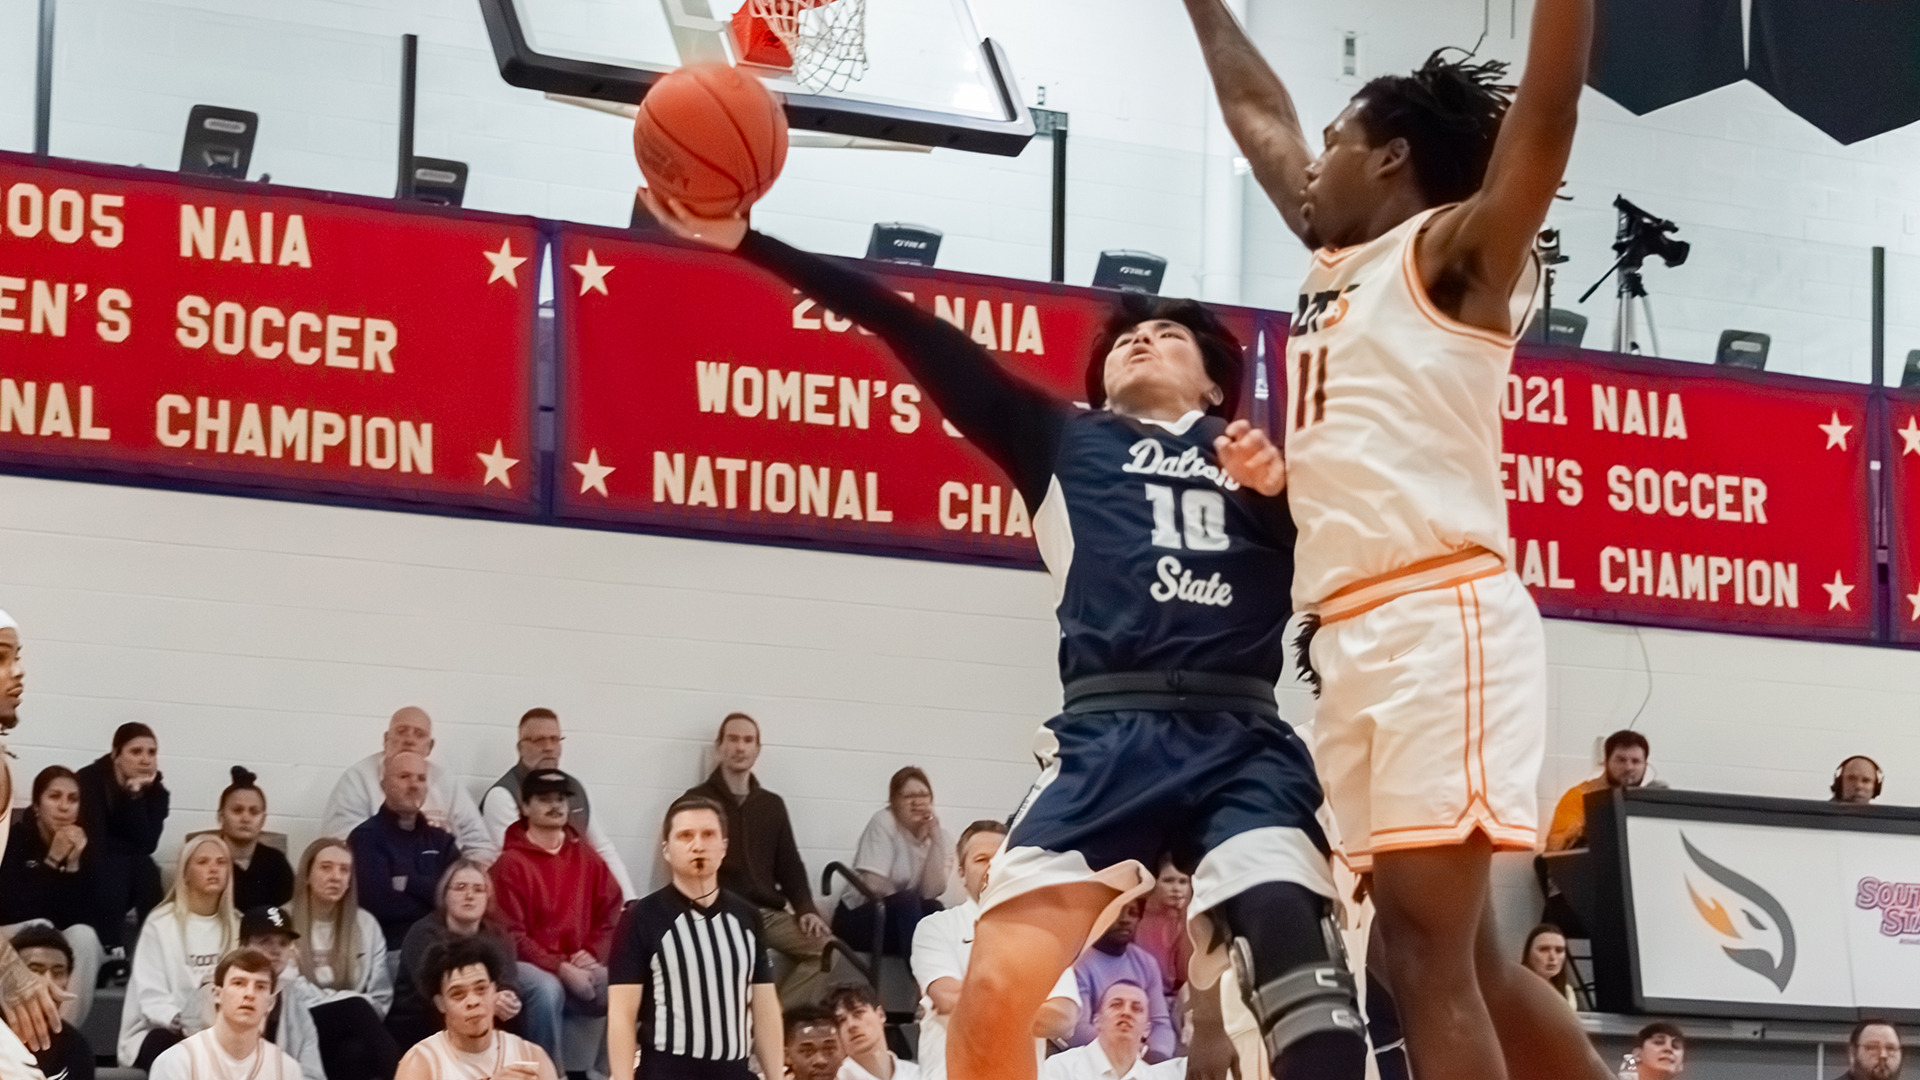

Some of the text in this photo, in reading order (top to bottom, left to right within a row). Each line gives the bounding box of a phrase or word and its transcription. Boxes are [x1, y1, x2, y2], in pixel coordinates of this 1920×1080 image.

[0, 182, 312, 268] 005 NAIA
[176, 295, 398, 373] SOCCER
[934, 295, 1045, 355] NAIA
[696, 361, 921, 434] WOMEN'S
[1296, 346, 1328, 431] 11
[1592, 384, 1688, 440] NAIA
[0, 378, 434, 474] NAL CHAMPION
[653, 451, 893, 523] NATIONAL
[1145, 483, 1230, 551] 10
[1607, 465, 1768, 524] SOCCER
[1150, 556, 1233, 608] State
[1600, 546, 1799, 608] CHAMPION
